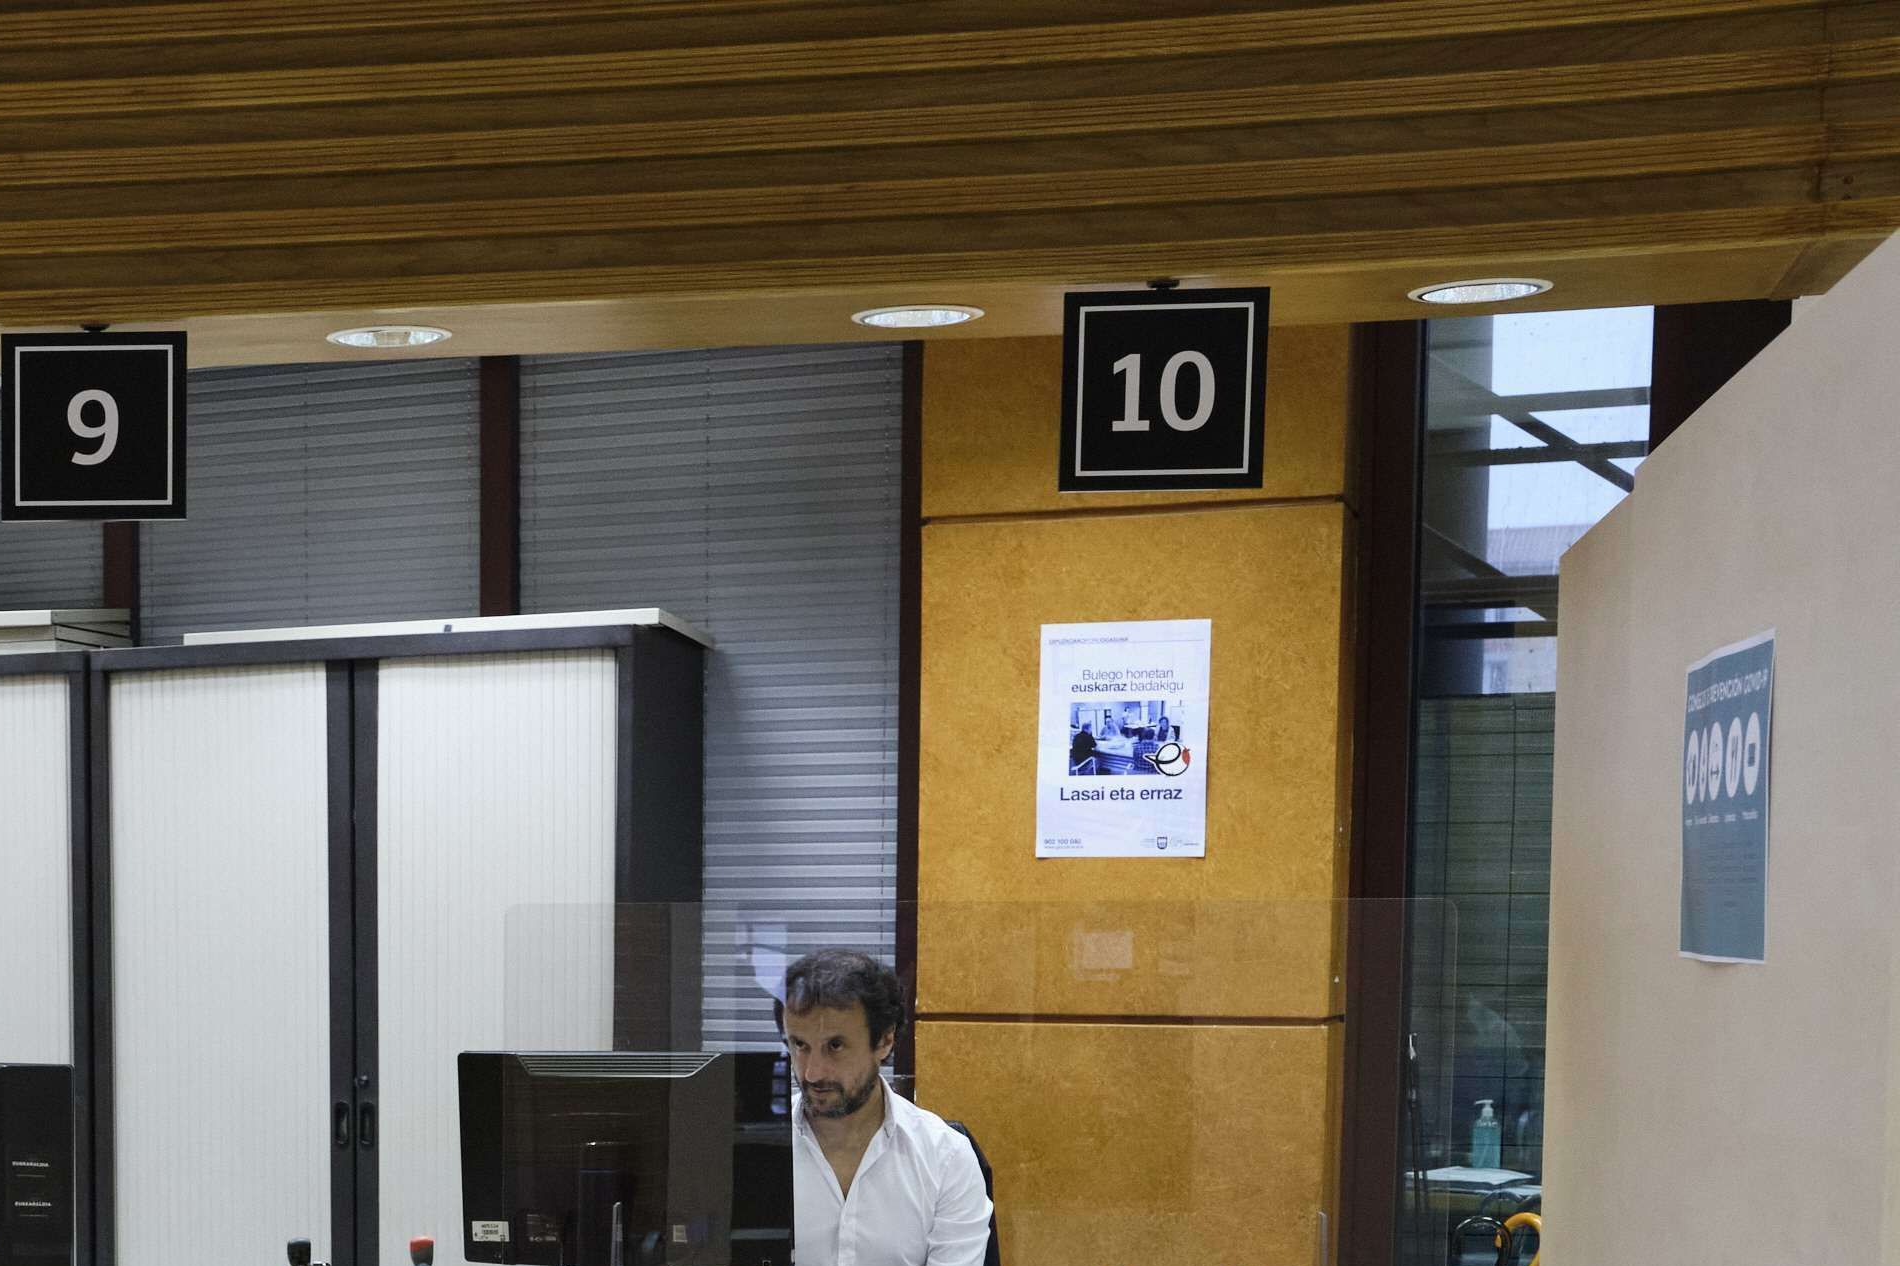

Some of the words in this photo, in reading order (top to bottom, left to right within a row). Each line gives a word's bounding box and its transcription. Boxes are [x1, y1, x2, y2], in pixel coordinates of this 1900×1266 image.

[1112, 351, 1215, 431] 10
[67, 390, 118, 465] 9
[1083, 670, 1123, 682] Bulego
[1126, 669, 1174, 679] honetan
[1071, 682, 1127, 692] euskaraz
[1130, 680, 1184, 692] badakigu
[1060, 788, 1105, 801] Lasai
[1110, 790, 1135, 800] eta
[1141, 788, 1182, 800] erraz
